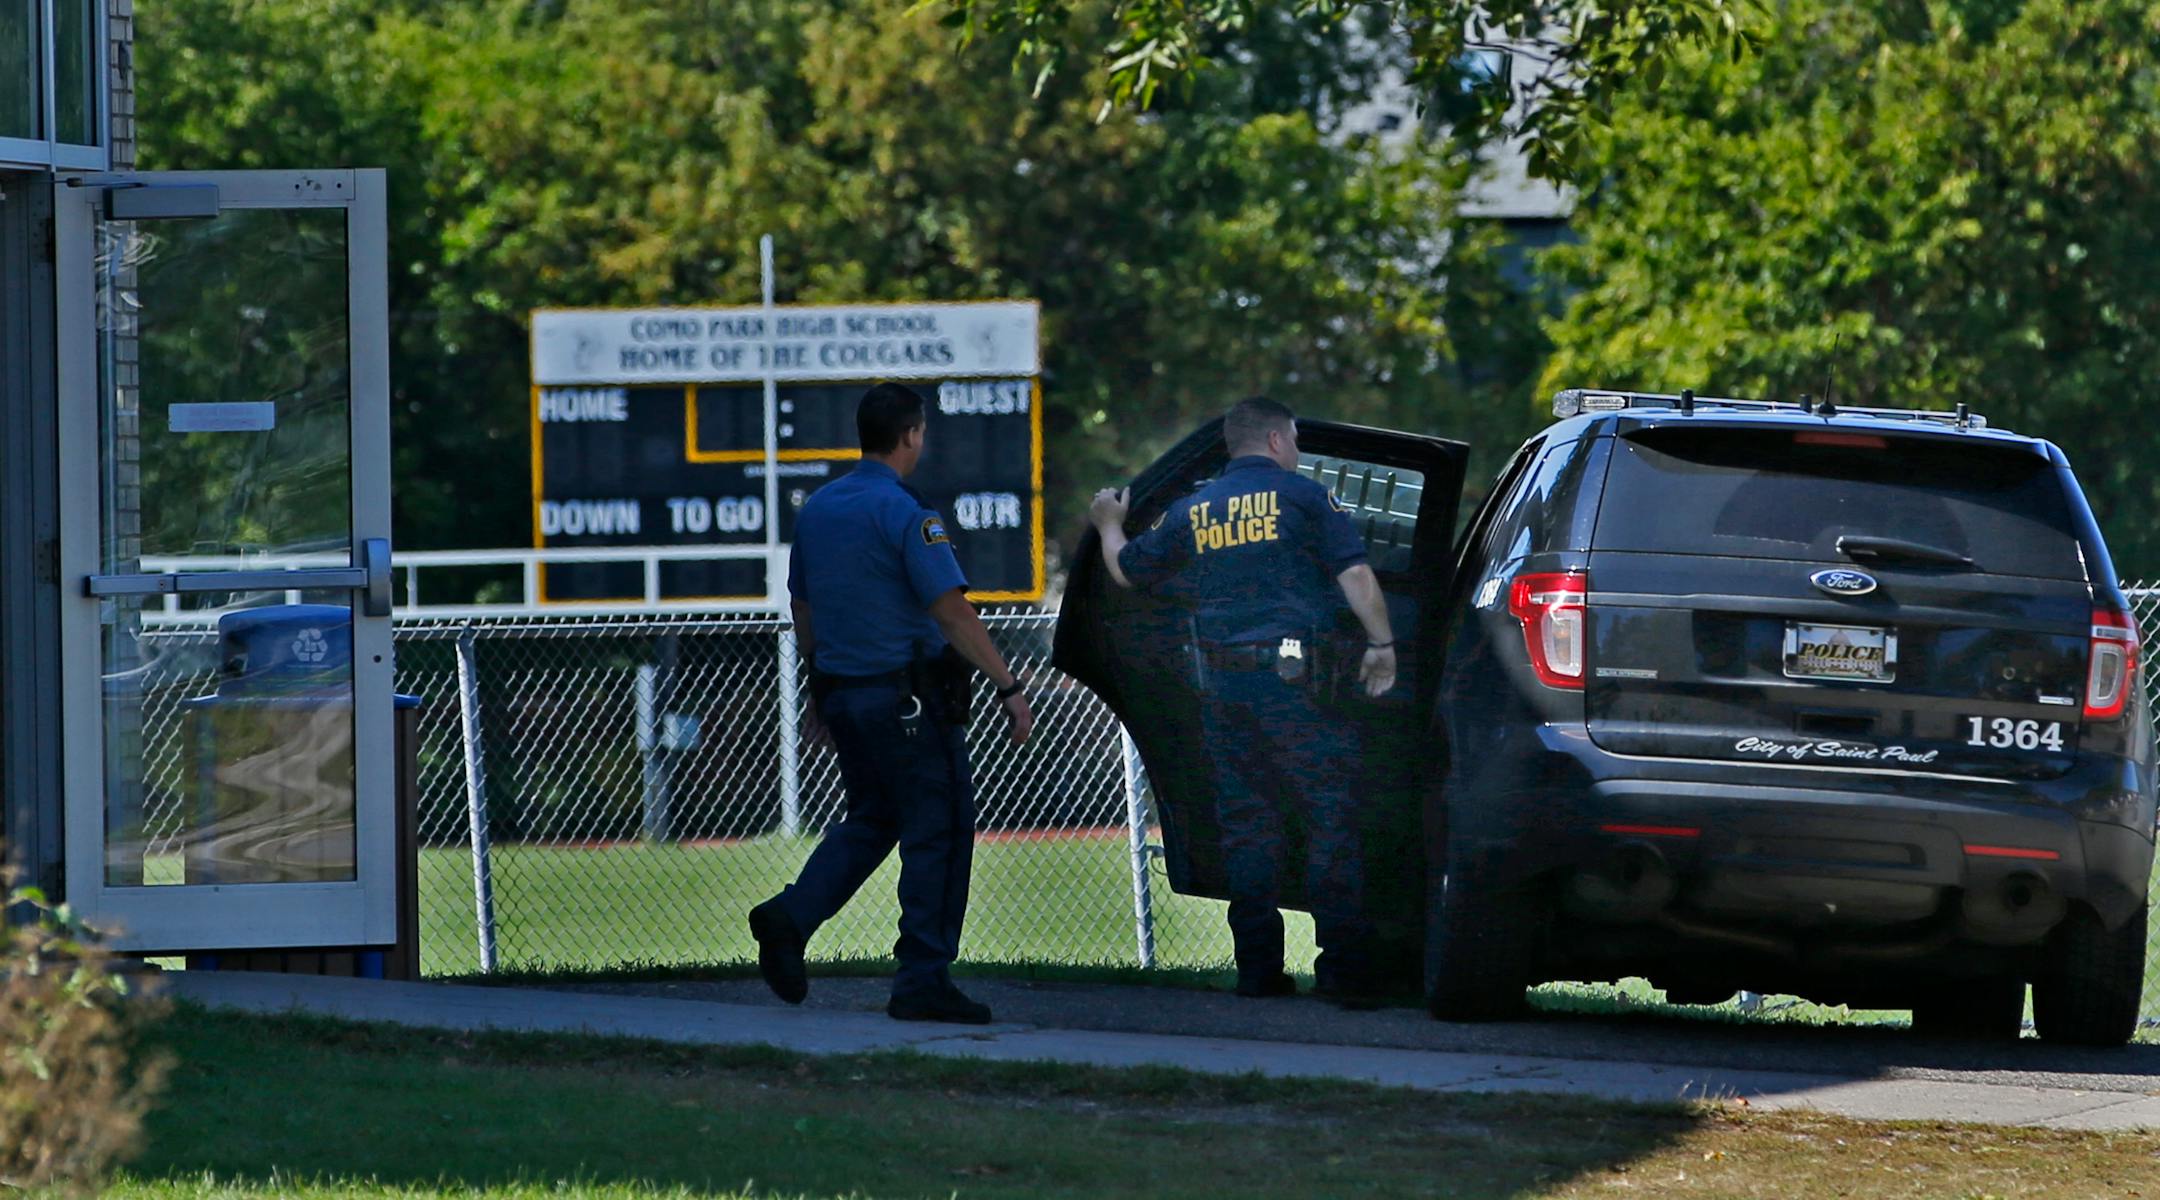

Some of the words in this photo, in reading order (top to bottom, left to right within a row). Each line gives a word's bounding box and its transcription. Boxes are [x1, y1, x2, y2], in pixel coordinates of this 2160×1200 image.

[619, 345, 697, 370] HOME
[711, 345, 742, 370] OF
[538, 388, 629, 422] HOME
[938, 382, 1031, 414] GUEST
[539, 500, 640, 536] DOWN
[666, 497, 711, 533] TO
[716, 497, 764, 532] GO
[955, 492, 1020, 530] QTR
[1189, 501, 1217, 530] ST.
[1228, 490, 1281, 521] PAUL
[1195, 516, 1278, 554] POLICE
[1827, 572, 1862, 589] Ford
[1798, 642, 1884, 661] POLICE
[1735, 737, 1784, 758] City
[1786, 743, 1813, 760] of
[1814, 741, 1878, 760] Saint
[1881, 745, 1938, 763] Paul
[1967, 716, 2065, 752] 1364
